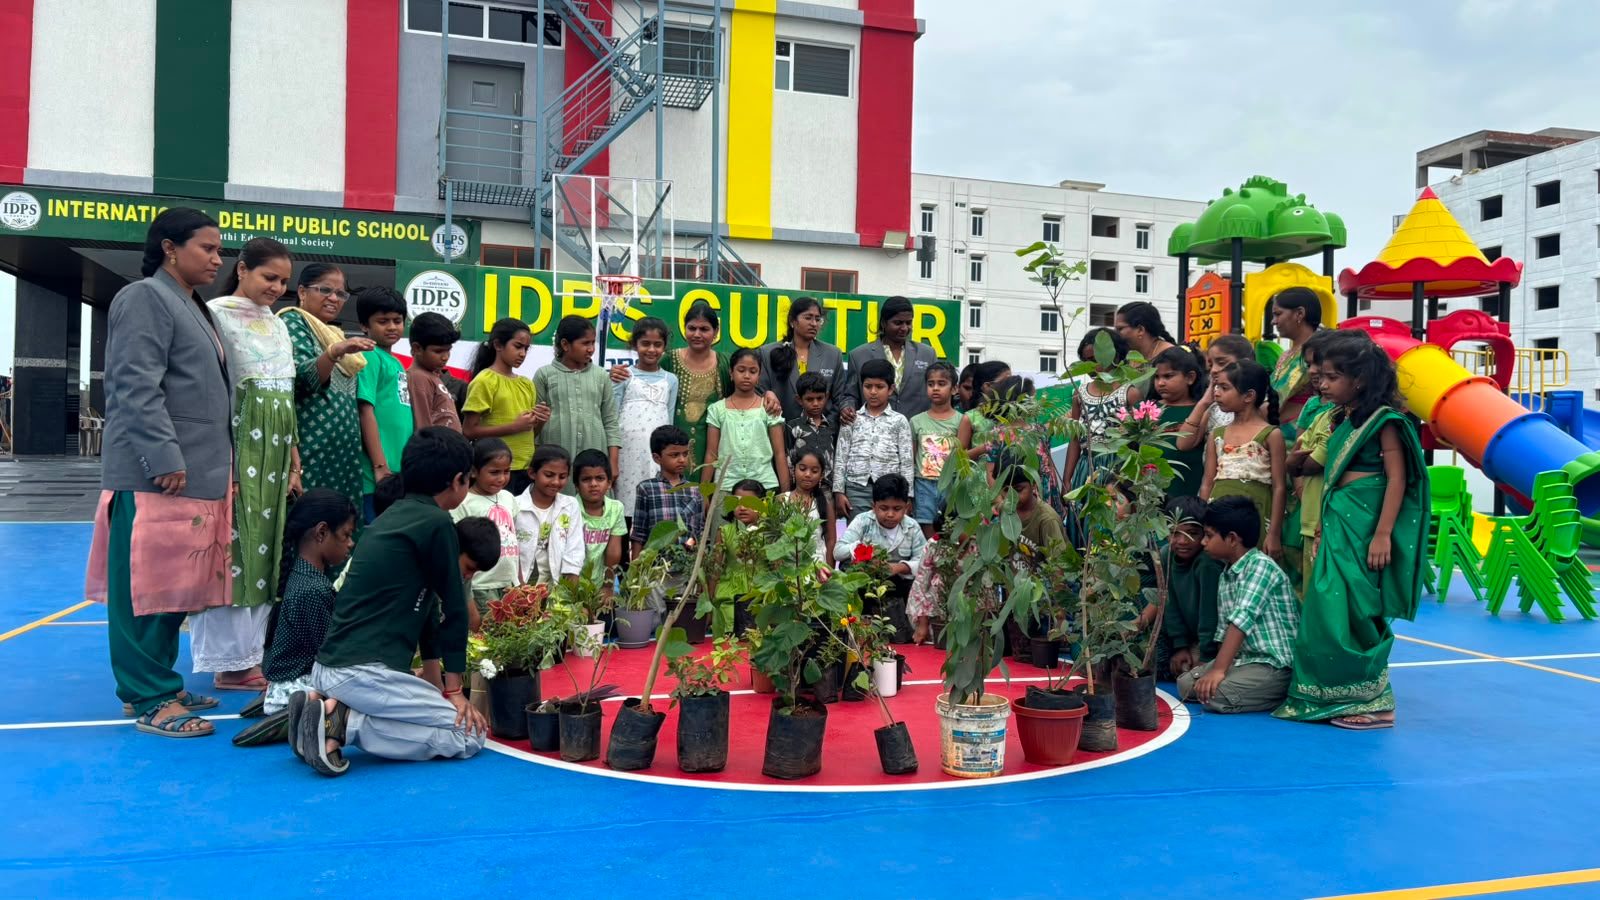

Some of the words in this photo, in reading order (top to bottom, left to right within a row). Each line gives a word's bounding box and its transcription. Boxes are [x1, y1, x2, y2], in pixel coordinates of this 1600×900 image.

[3, 202, 37, 216] IDPS
[47, 198, 206, 224] INTERNATI
[219, 211, 275, 232] DELHI
[283, 216, 351, 237] PUBLIC
[357, 220, 430, 242] SCHOOL
[301, 238, 335, 249] Society
[411, 288, 460, 308] IDPS
[483, 273, 653, 343] IDPS
